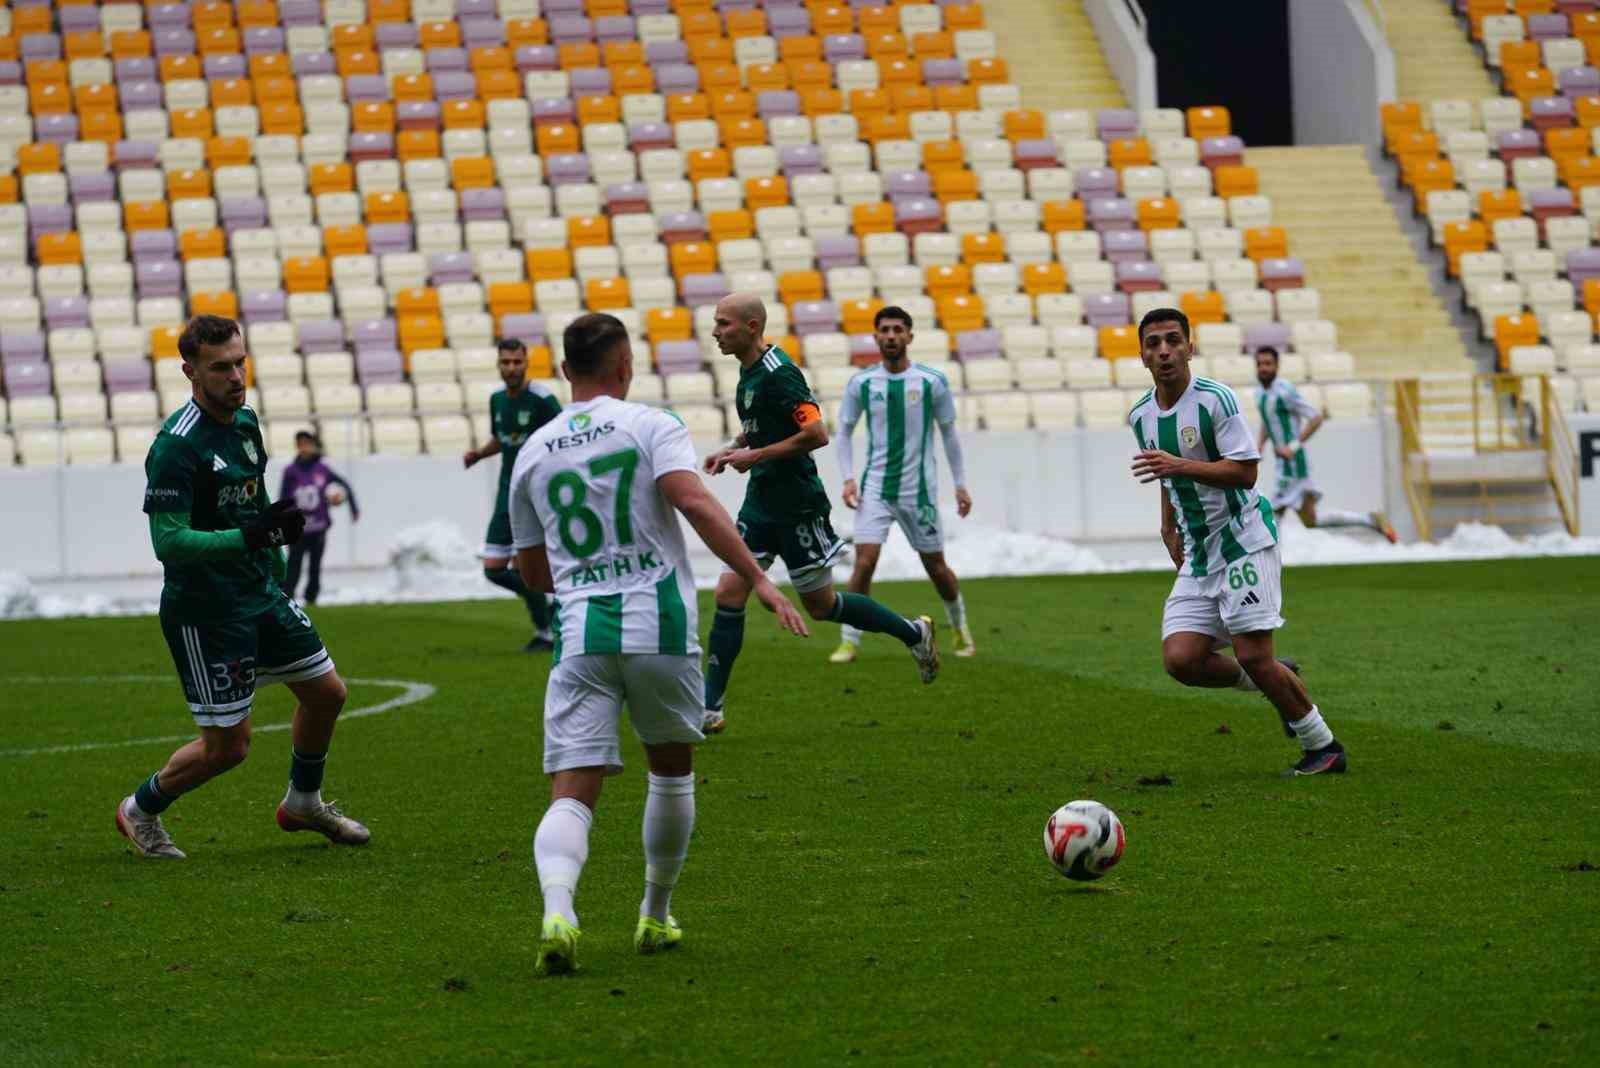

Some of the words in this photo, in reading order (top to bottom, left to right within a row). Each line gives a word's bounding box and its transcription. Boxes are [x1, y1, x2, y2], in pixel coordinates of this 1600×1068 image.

[548, 447, 638, 559] 87
[795, 524, 814, 548] 8
[639, 550, 664, 571] K.
[1228, 560, 1259, 590] 66
